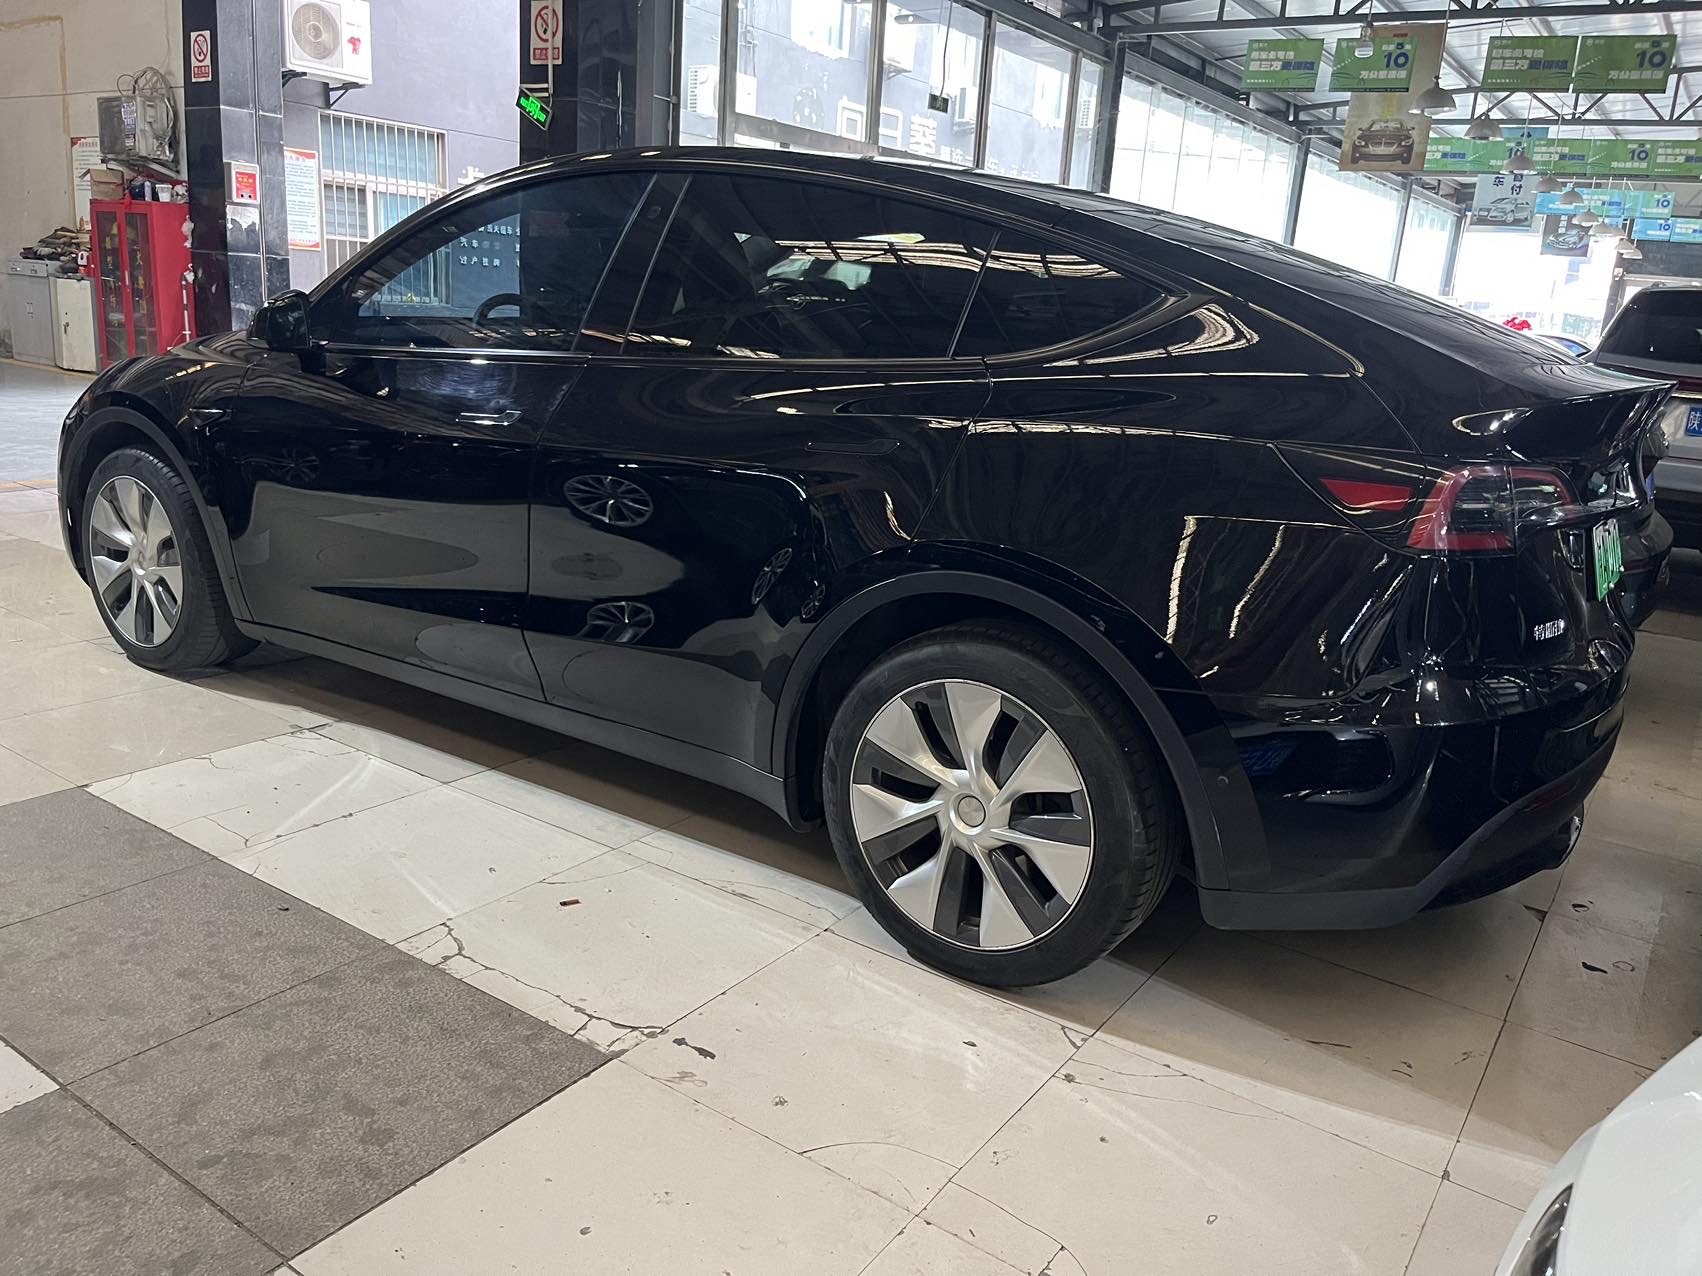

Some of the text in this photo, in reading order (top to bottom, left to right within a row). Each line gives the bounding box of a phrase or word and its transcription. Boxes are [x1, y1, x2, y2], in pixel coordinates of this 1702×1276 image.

[1384, 52, 1409, 68] 10
[1636, 50, 1667, 68] 10
[1628, 149, 1649, 161] 10
[1655, 198, 1670, 208] 10
[1658, 223, 1671, 231] 10
[1688, 411, 1702, 432] 陕
